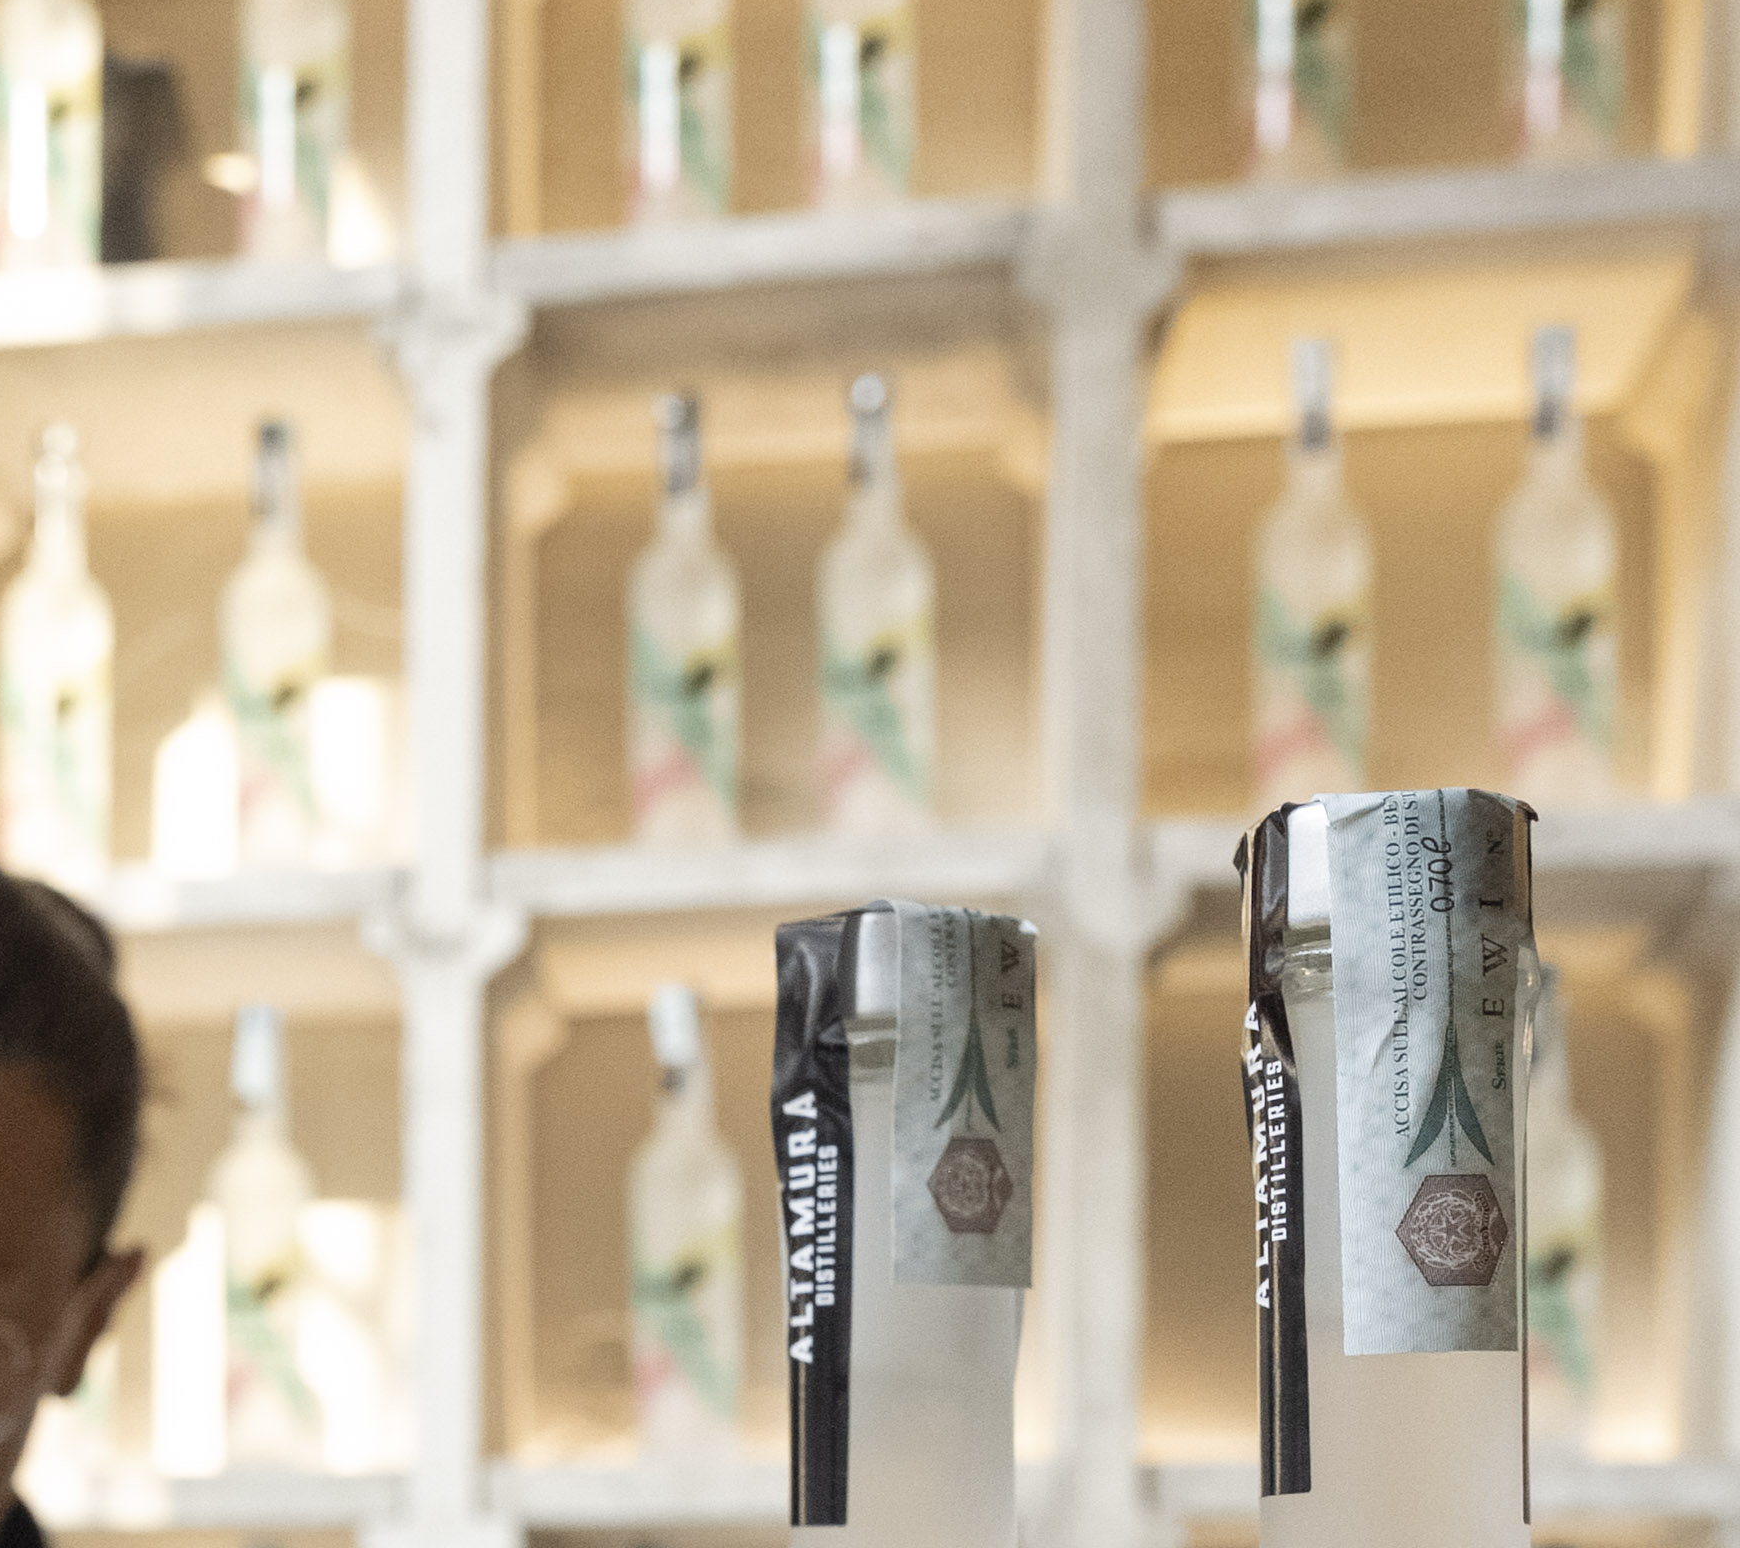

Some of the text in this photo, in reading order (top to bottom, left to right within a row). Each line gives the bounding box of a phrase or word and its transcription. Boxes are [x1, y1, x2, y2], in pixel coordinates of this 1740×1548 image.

[1386, 843, 1405, 922] ETILICO
[1404, 813, 1420, 836] DI
[1390, 927, 1409, 1064] SULL'ALCOLE
[1405, 842, 1427, 1001] CONTRASSEGNO
[1241, 999, 1271, 1310] ALTAMURA
[1265, 1059, 1288, 1242] DISTILLERIES
[1394, 1068, 1410, 1137] ACCISA
[782, 1090, 818, 1364] ALTAMURA
[815, 1144, 838, 1307] DISTILLERIES
